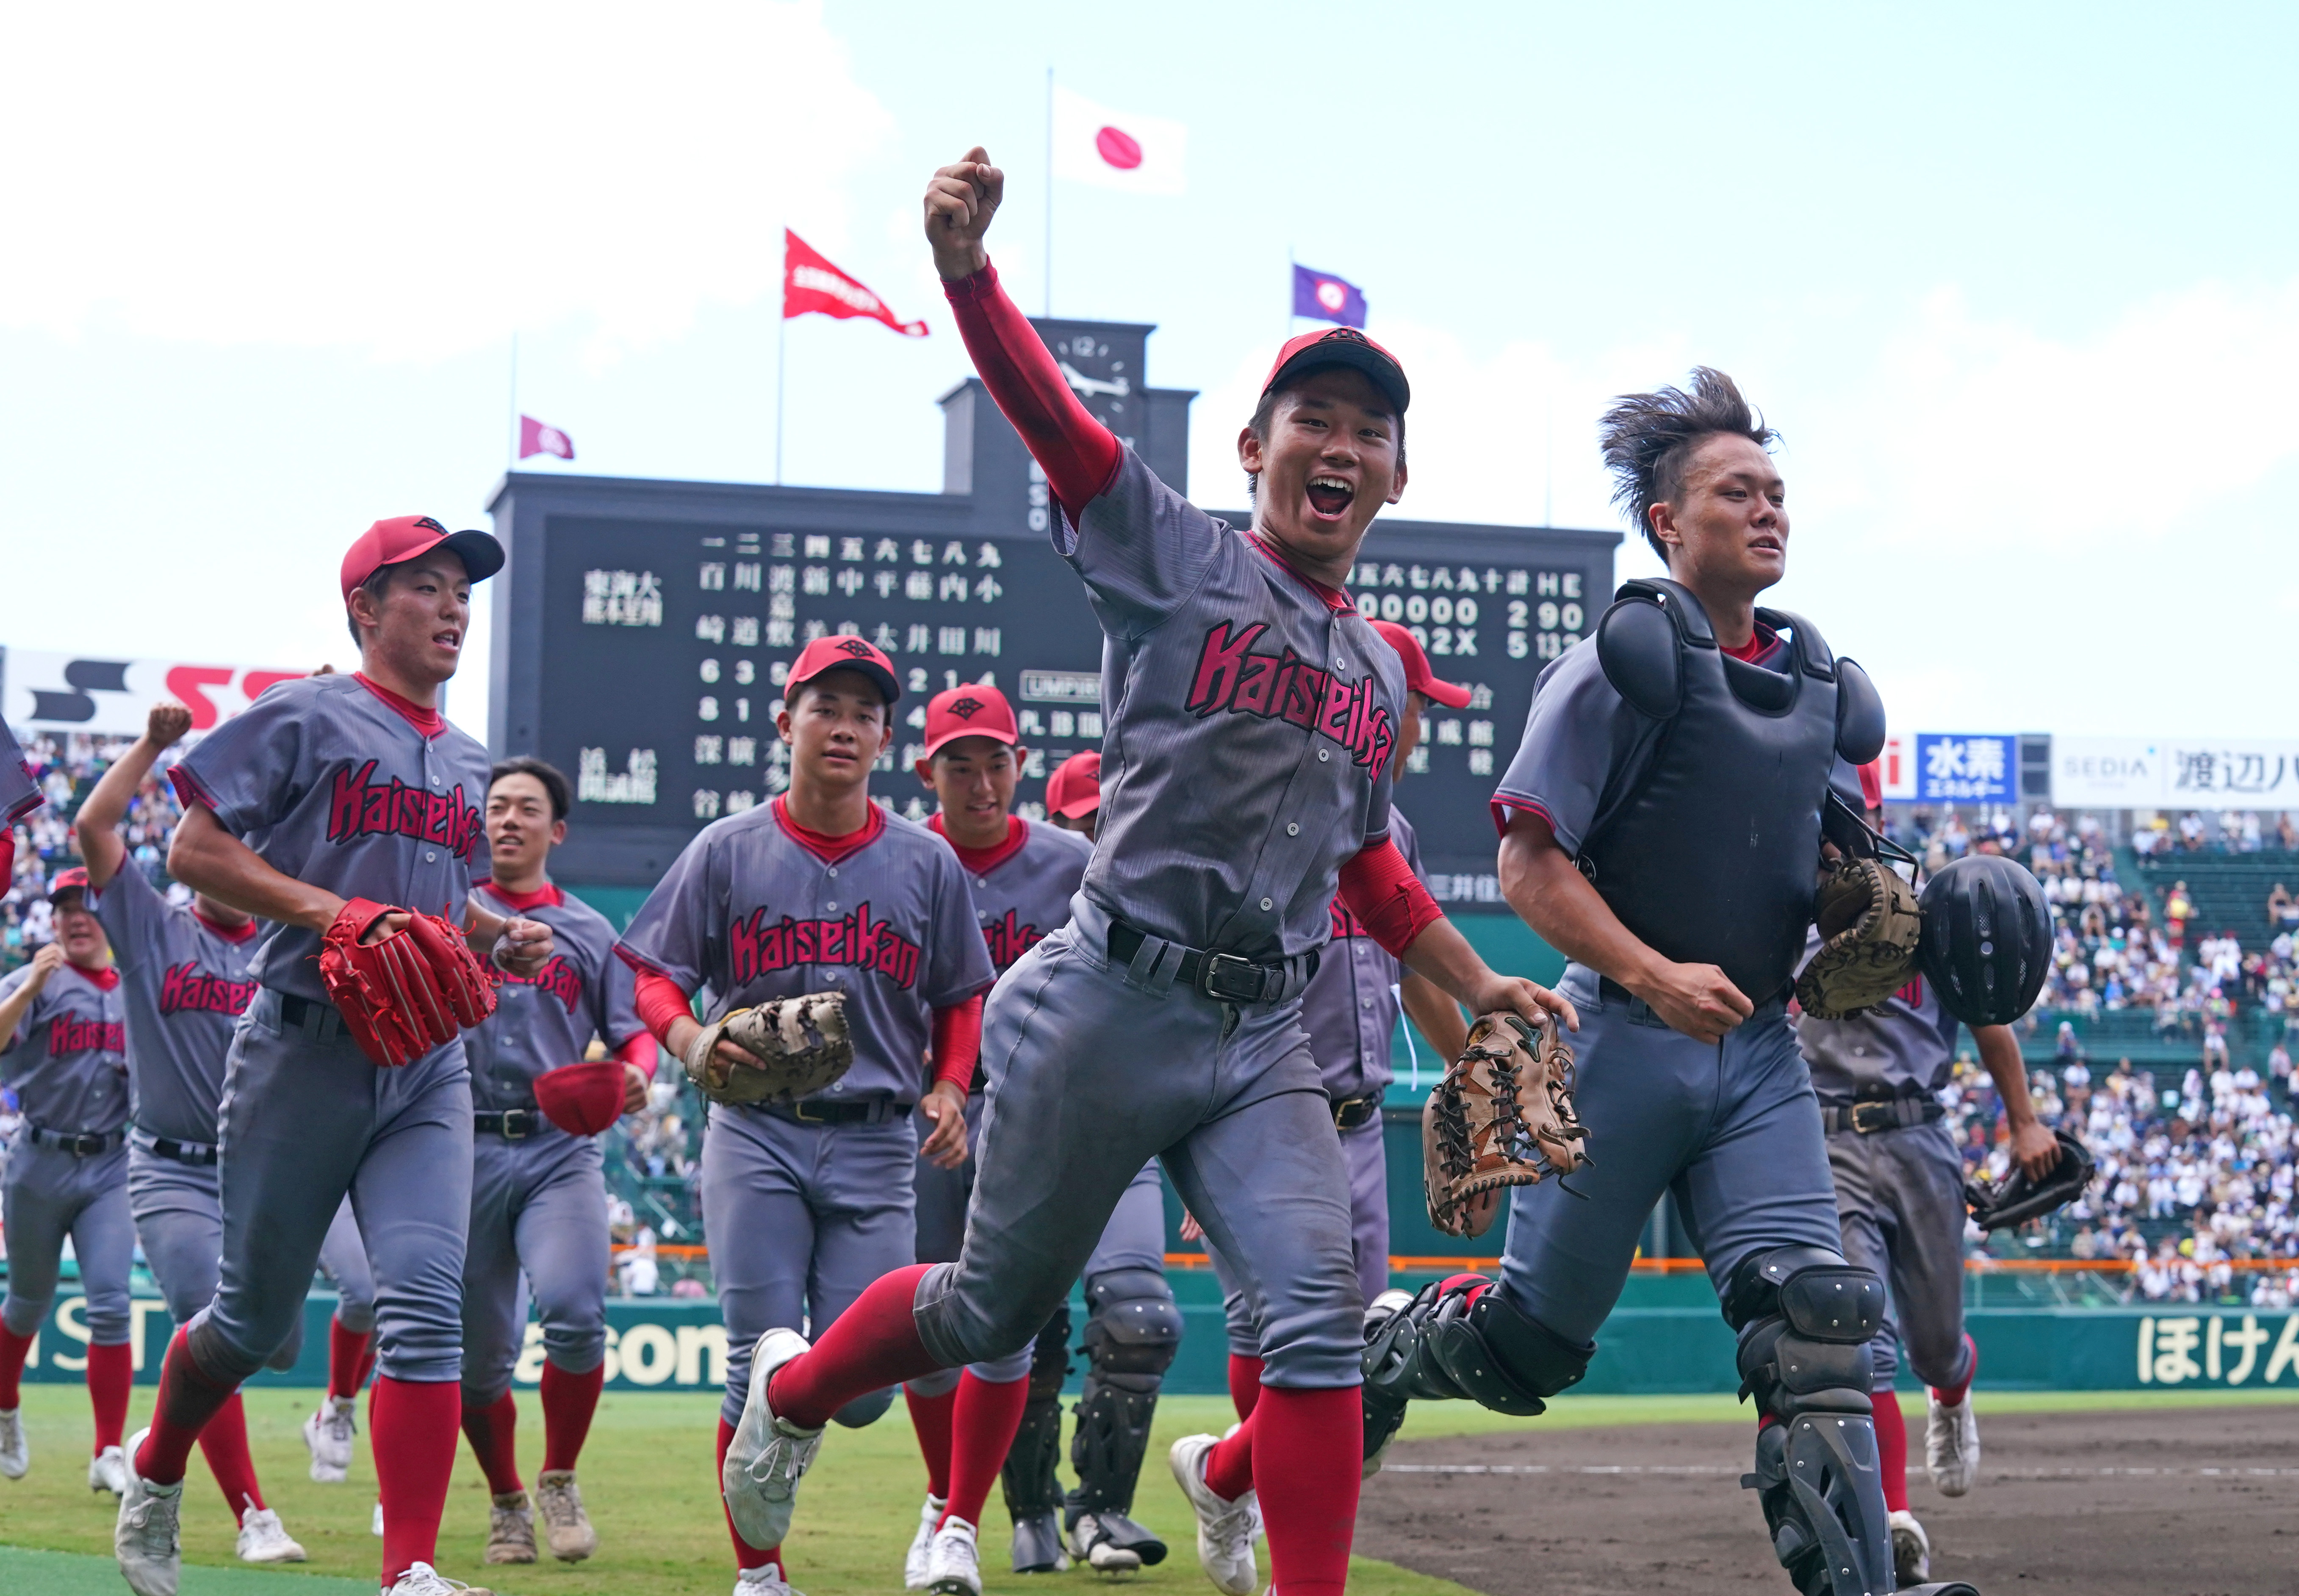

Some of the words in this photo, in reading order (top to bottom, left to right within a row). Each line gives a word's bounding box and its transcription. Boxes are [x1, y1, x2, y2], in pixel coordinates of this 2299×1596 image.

[1537, 571, 1559, 597] H
[1562, 573, 1583, 598] E
[1507, 600, 1529, 628] 2
[1537, 602, 1559, 630] 9
[1561, 603, 1584, 631] 0
[1507, 631, 1529, 659] 5
[700, 658, 720, 684] 6
[735, 659, 755, 685] 3
[909, 667, 928, 692] 2
[735, 697, 750, 722] 1
[1926, 736, 2005, 781] 水素
[2064, 755, 2148, 778] SEDIA
[1427, 873, 1505, 902] 三井住
[731, 901, 921, 990] Kaiseikan
[2137, 1314, 2299, 1386] ほけん
